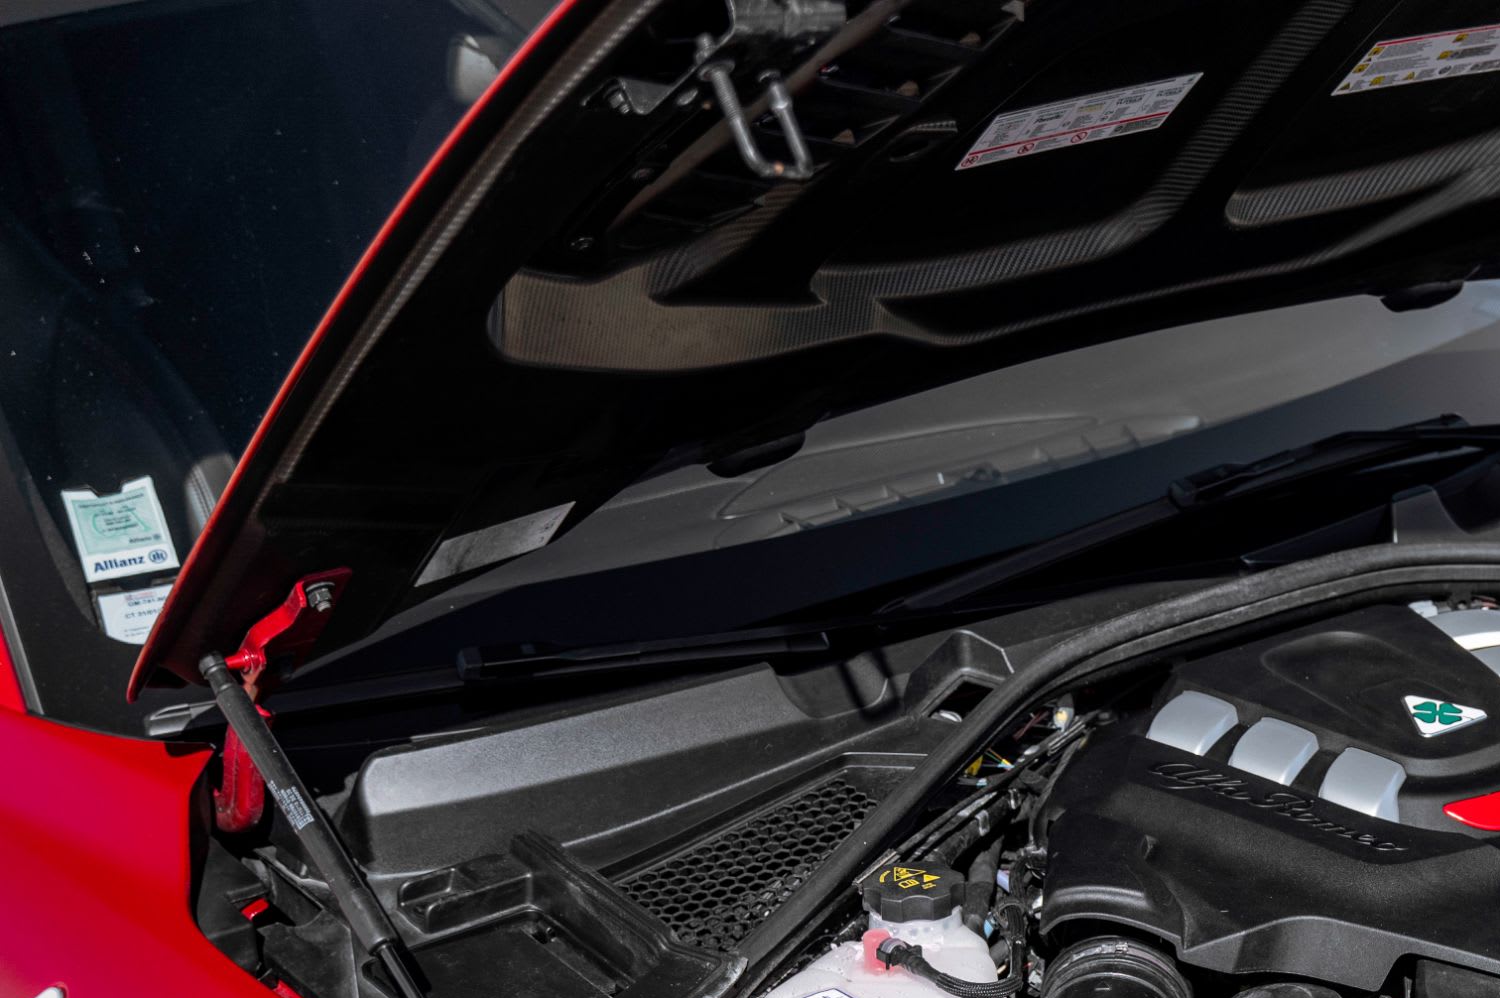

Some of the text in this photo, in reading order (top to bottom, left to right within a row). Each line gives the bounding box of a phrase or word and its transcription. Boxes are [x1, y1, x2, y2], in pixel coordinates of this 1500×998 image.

[93, 555, 146, 573] Allianz
[1149, 763, 1406, 851] Alfa Romeo
